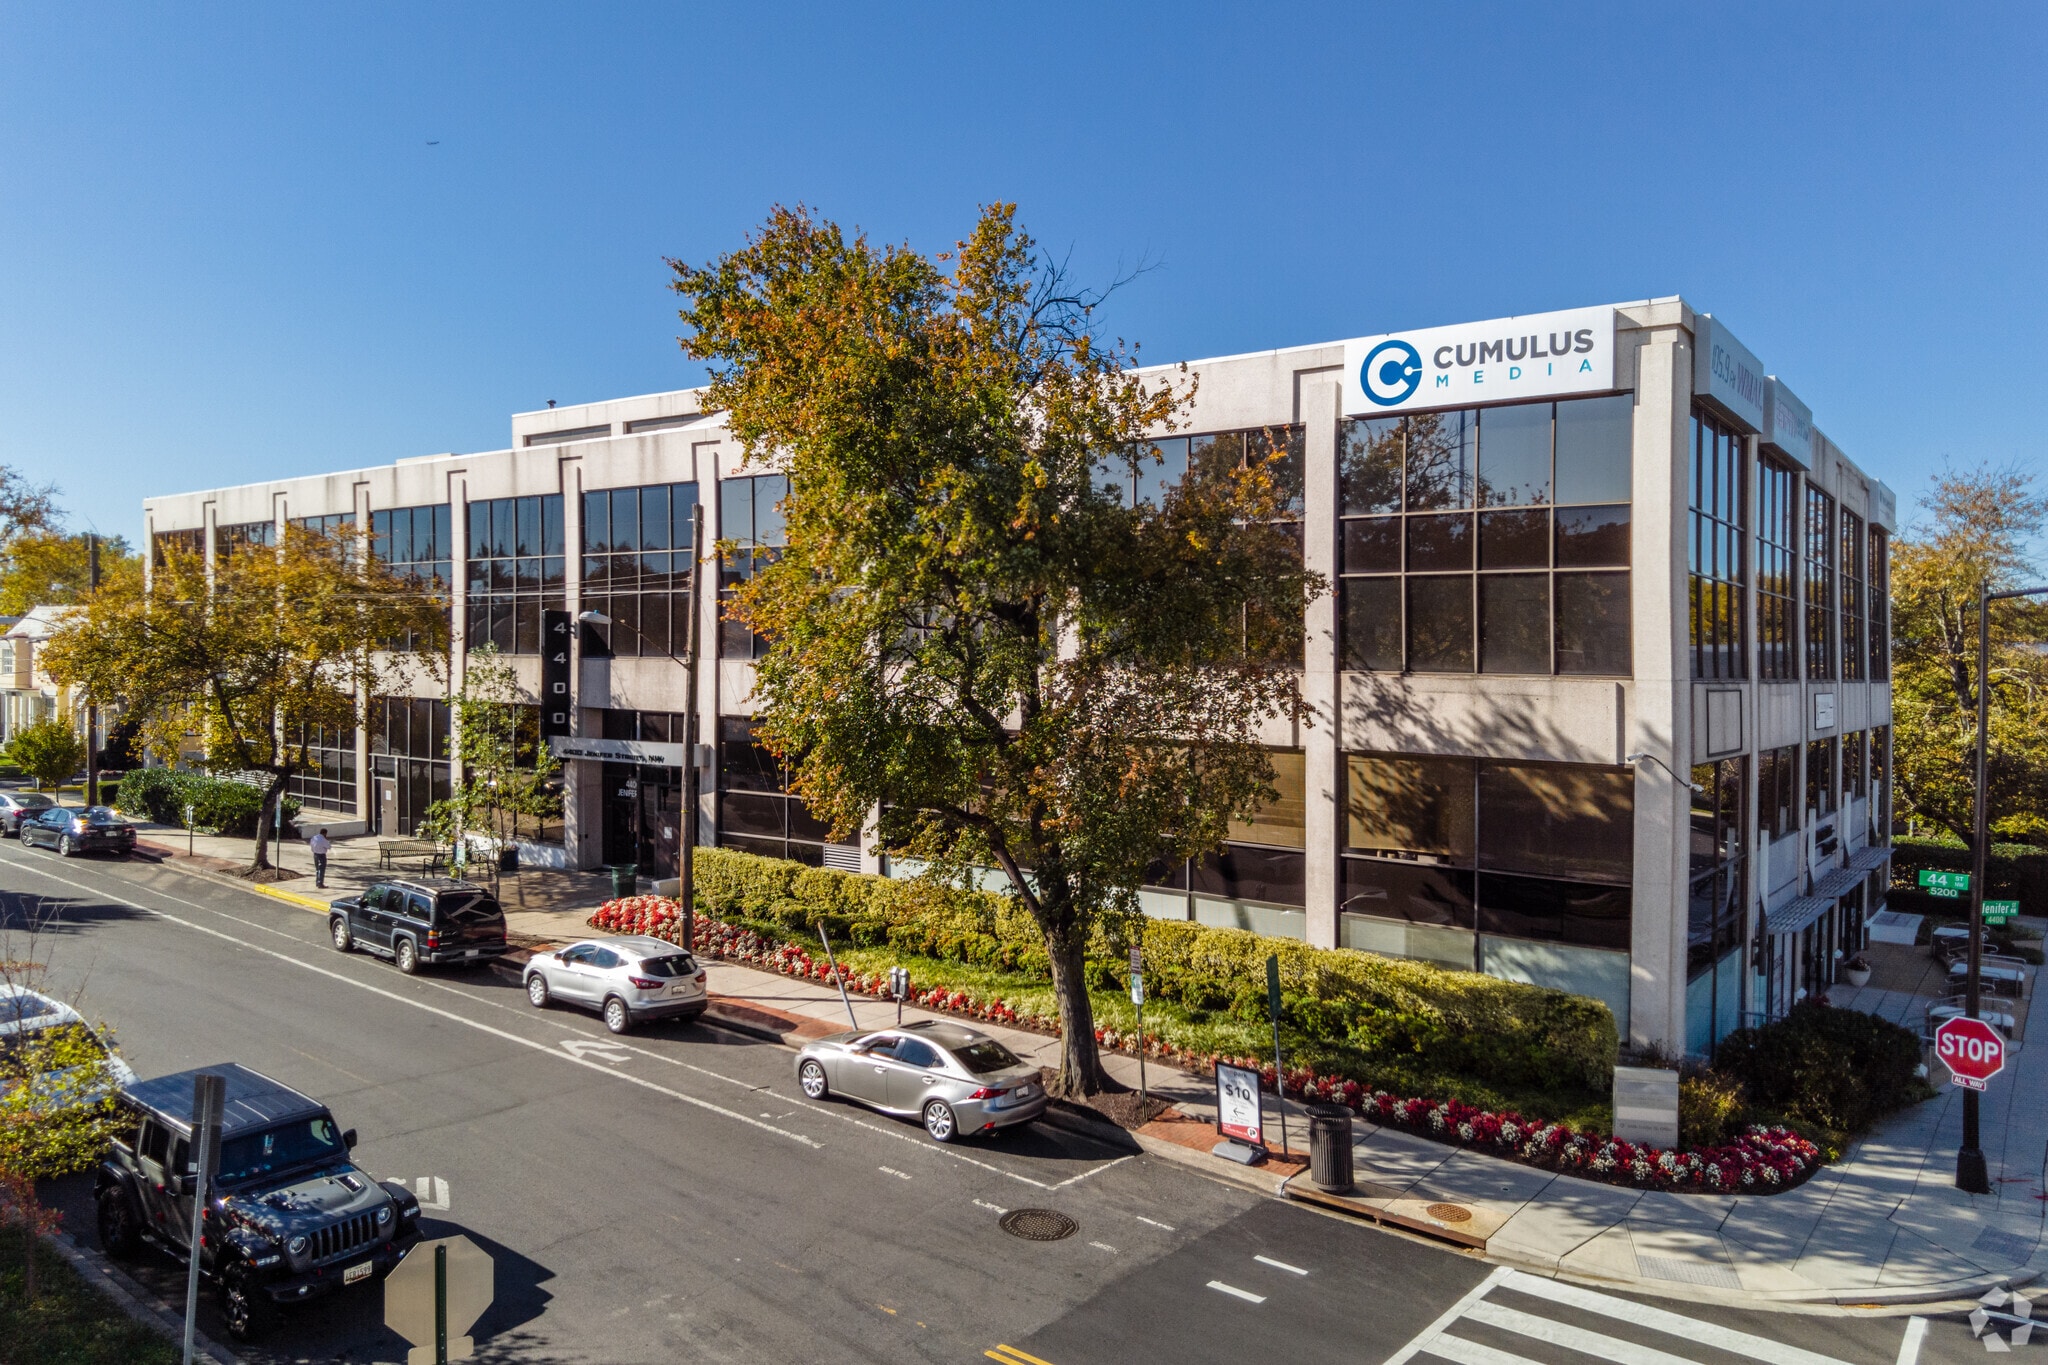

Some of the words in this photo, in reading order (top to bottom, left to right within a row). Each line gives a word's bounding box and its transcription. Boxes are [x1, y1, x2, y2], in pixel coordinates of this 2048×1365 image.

[1433, 328, 1594, 370] CUMULUS
[1436, 358, 1593, 388] MEDIA
[553, 622, 567, 724] 4400
[1927, 873, 1948, 886] 44
[1929, 887, 1958, 897] 5200
[1987, 915, 2004, 923] 4400
[1941, 1032, 1999, 1064] STOP
[1954, 1076, 1967, 1085] ALL
[1969, 1079, 1983, 1089] WAY
[1225, 1083, 1250, 1101] $10
